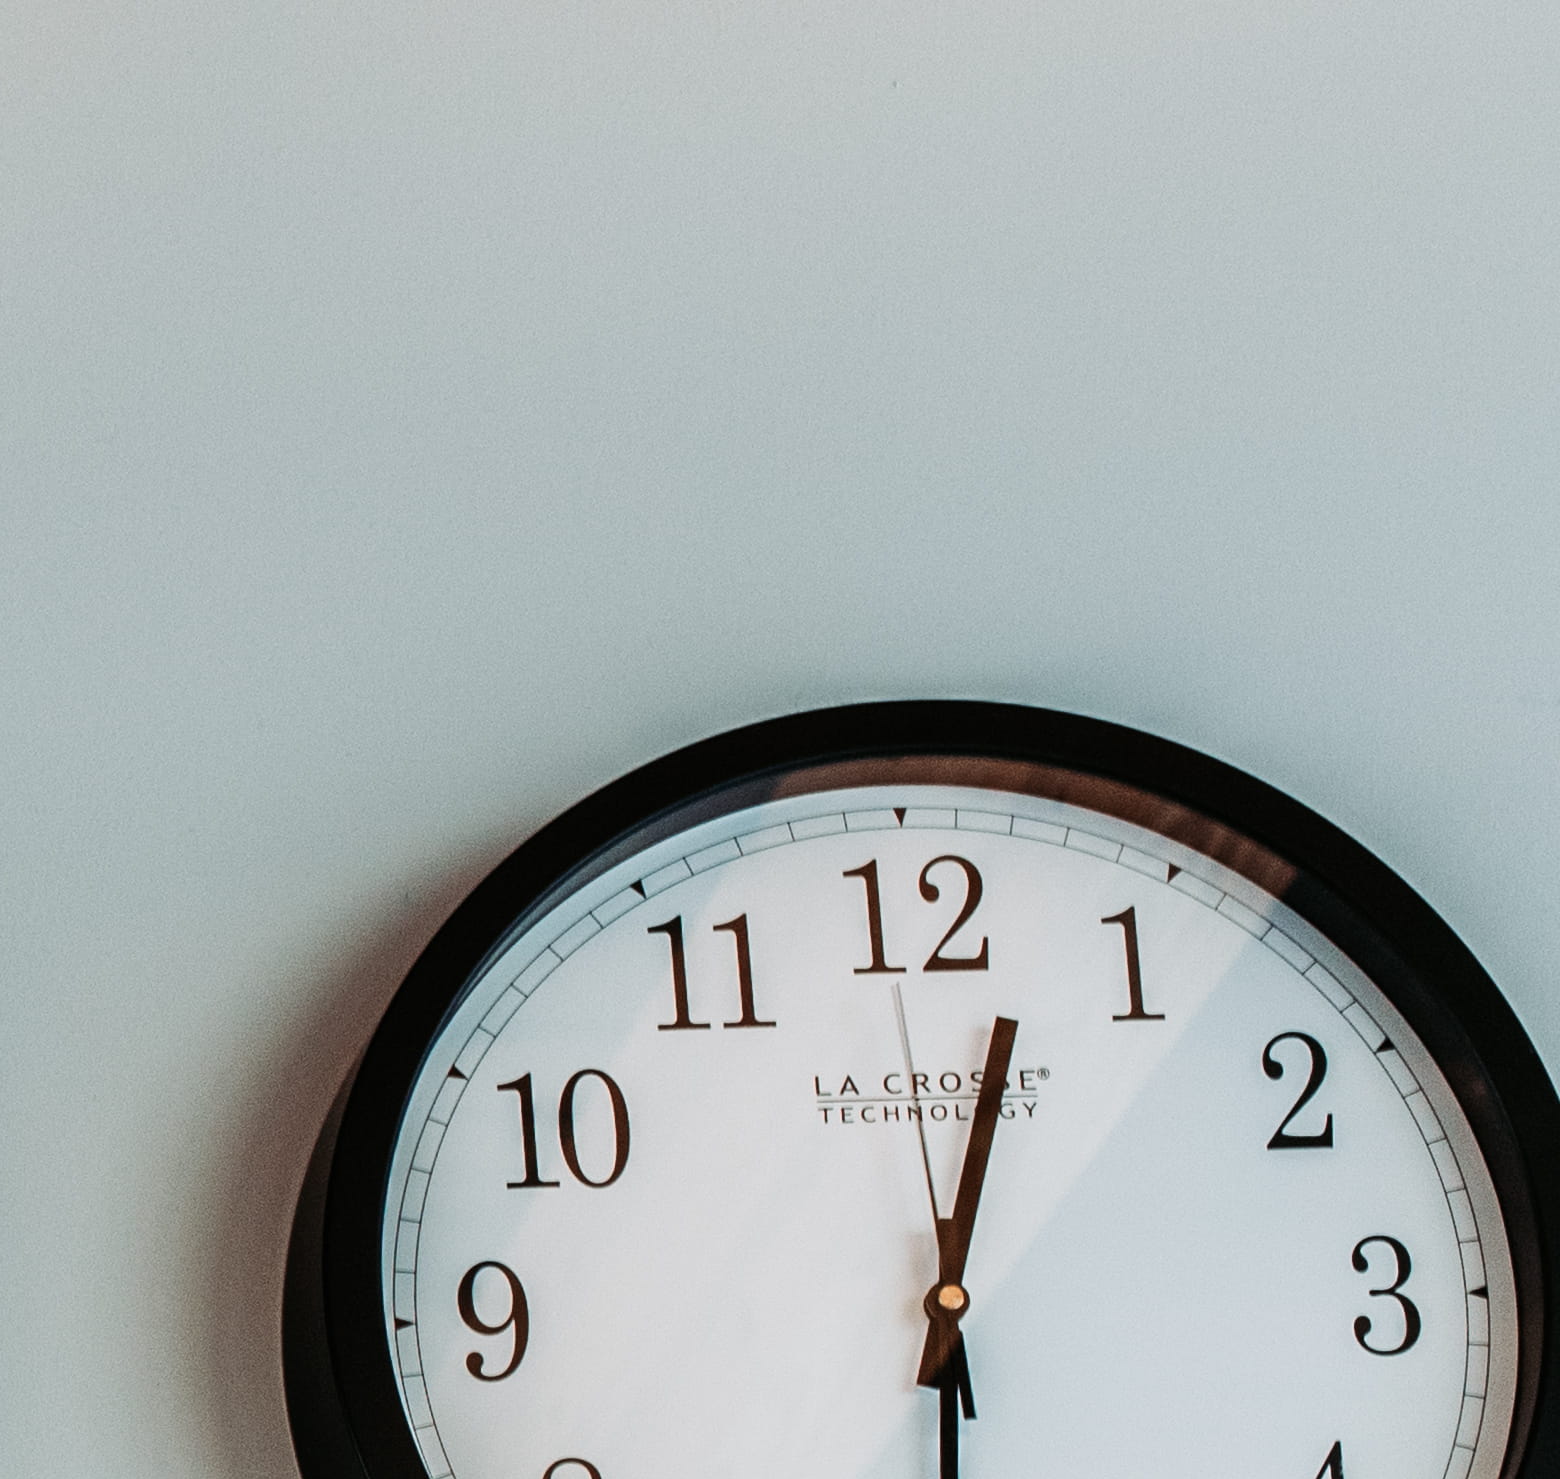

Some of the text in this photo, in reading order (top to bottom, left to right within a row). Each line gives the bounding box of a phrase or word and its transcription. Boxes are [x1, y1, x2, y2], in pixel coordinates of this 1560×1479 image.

[647, 913, 776, 1030] 11
[843, 855, 988, 974] 12
[1101, 906, 1165, 1021] 1
[497, 1069, 630, 1189] 10
[815, 1075, 860, 1096] LA
[818, 1102, 1037, 1124] TECHNOLGY
[1263, 1032, 1333, 1150] 2
[458, 1261, 529, 1382] 9
[1352, 1235, 1421, 1356] 3
